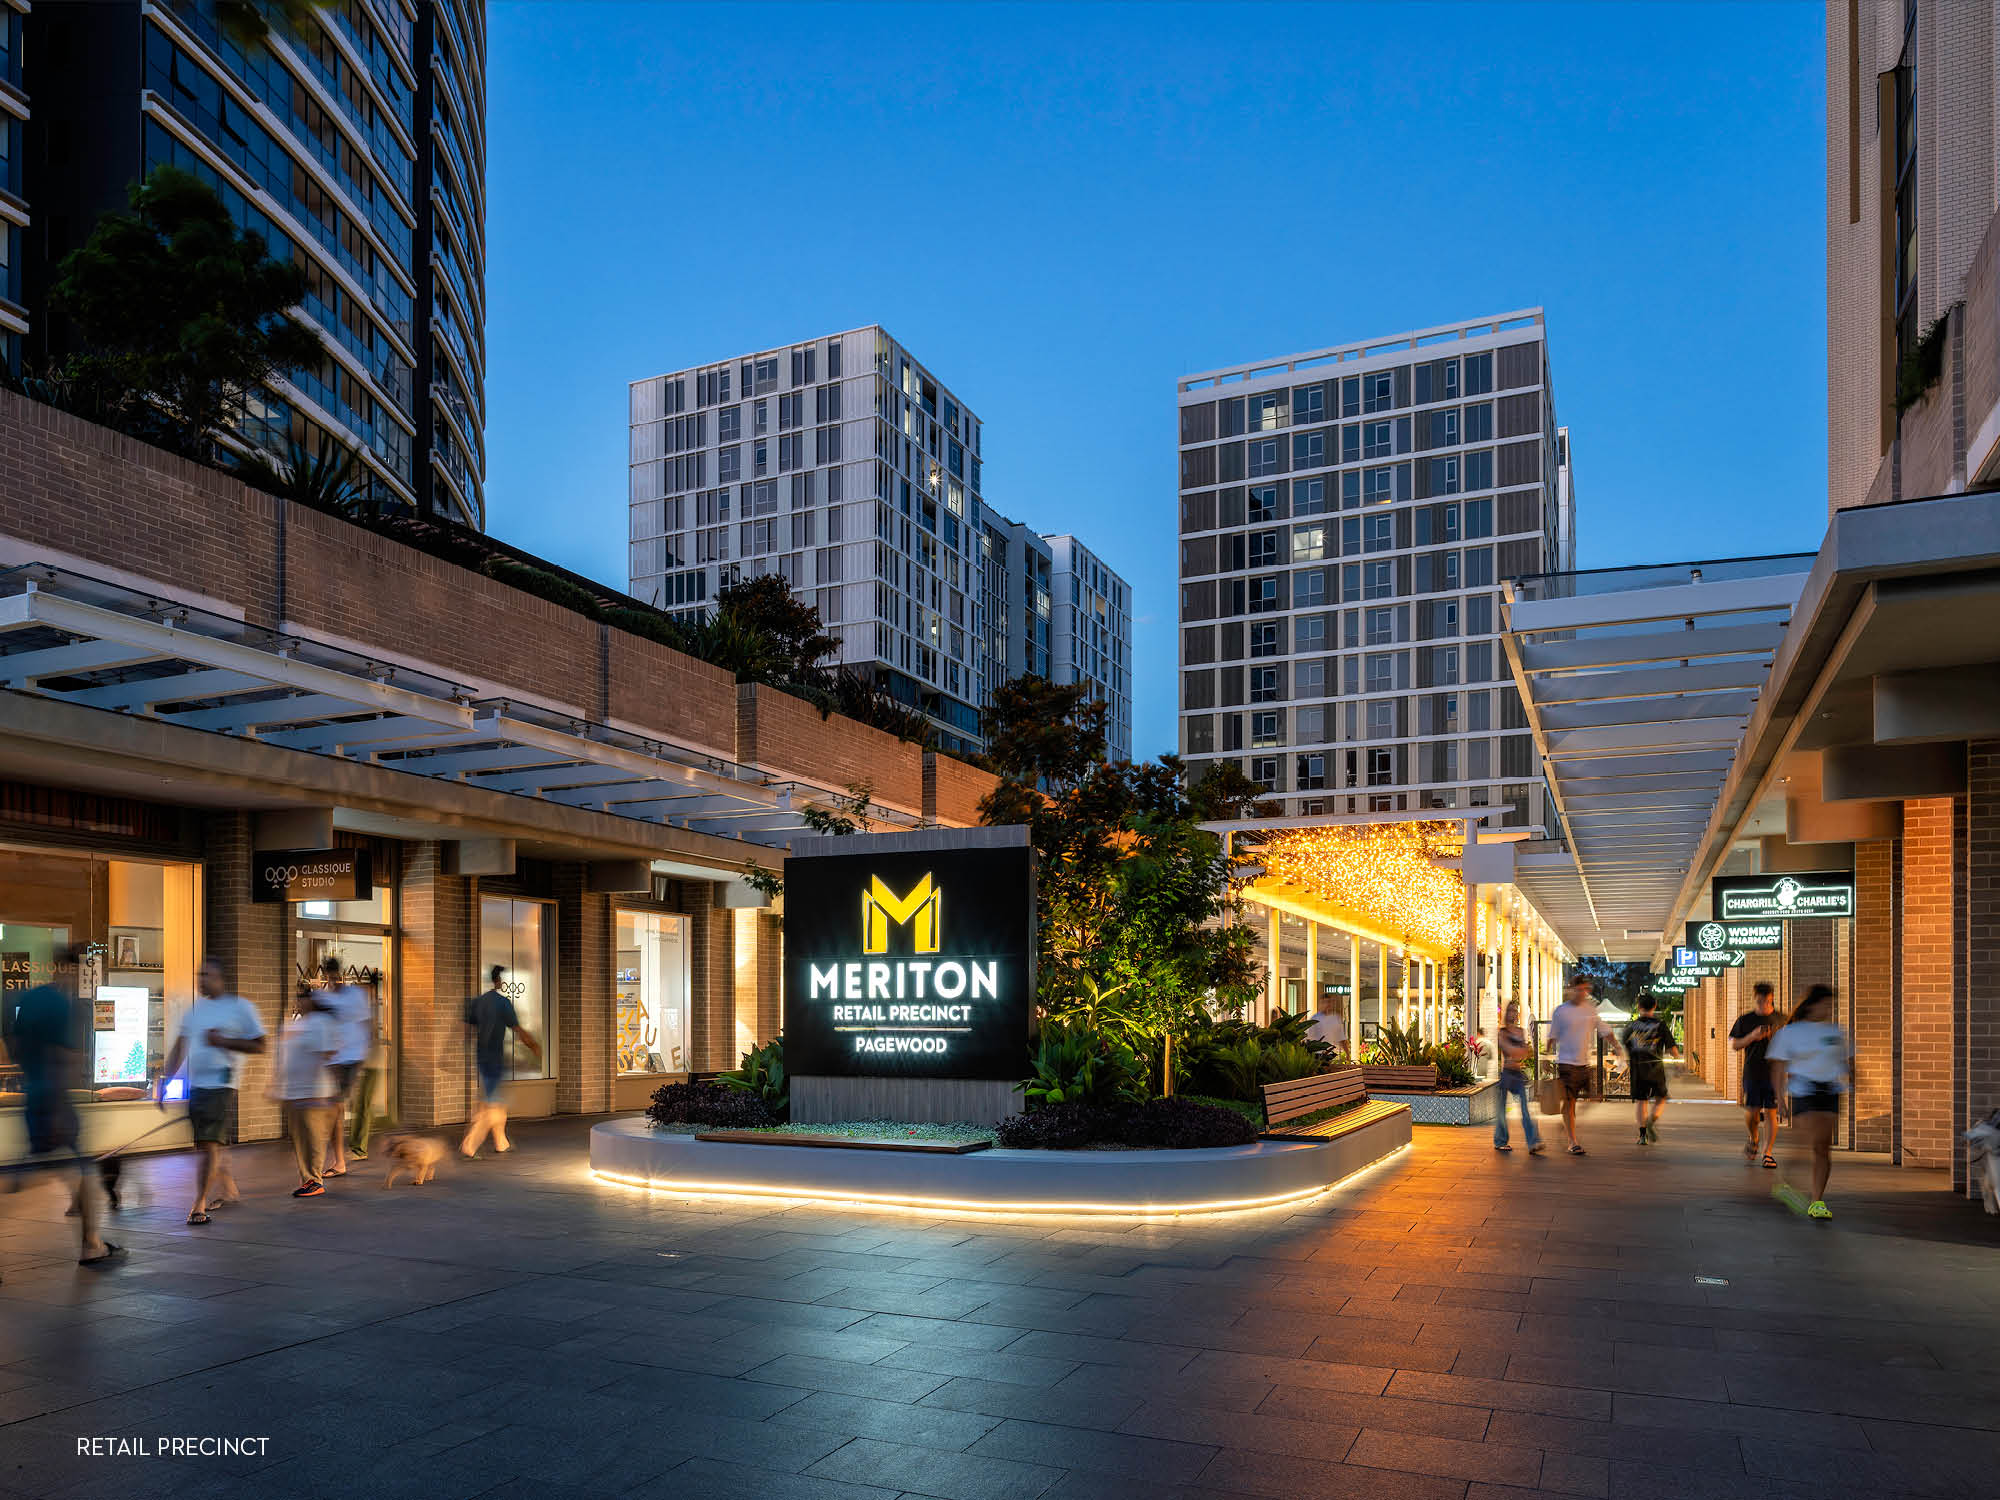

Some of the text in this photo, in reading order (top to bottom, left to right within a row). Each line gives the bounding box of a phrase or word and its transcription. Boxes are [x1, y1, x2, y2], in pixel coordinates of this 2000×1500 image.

[301, 862, 351, 875] GLASSIQUE
[301, 876, 335, 888] STUDIO
[1727, 896, 1847, 909] CHARGRILL CHARLIE'S
[1728, 926, 1781, 937] WOMBAT
[1729, 936, 1780, 945] PHARMACY
[1700, 954, 1731, 962] PARKING
[810, 961, 998, 999] MERITON
[834, 1005, 972, 1021] RETAIL PRECINCT
[855, 1038, 948, 1053] PAGEWOOD
